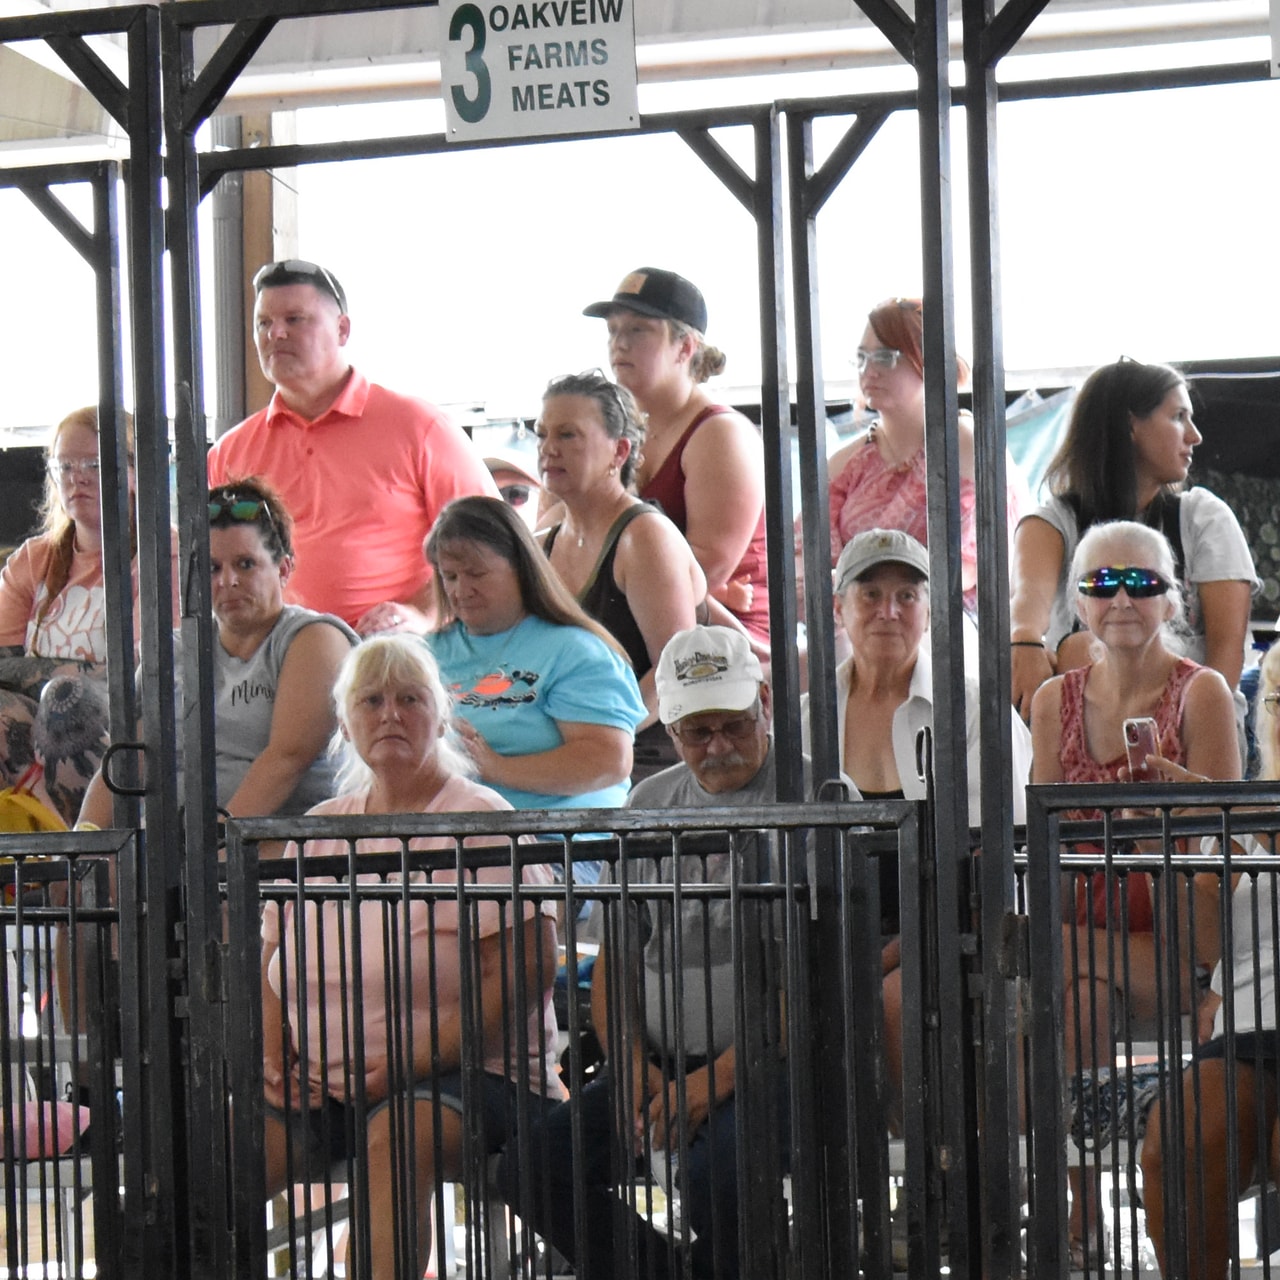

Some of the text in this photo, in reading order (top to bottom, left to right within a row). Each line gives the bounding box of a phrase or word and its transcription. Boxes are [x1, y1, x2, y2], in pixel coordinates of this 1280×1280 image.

[489, 0, 623, 32] OAKVEIW
[449, 3, 491, 123] 3
[508, 38, 609, 71] FARMS
[511, 79, 611, 112] MEATS
